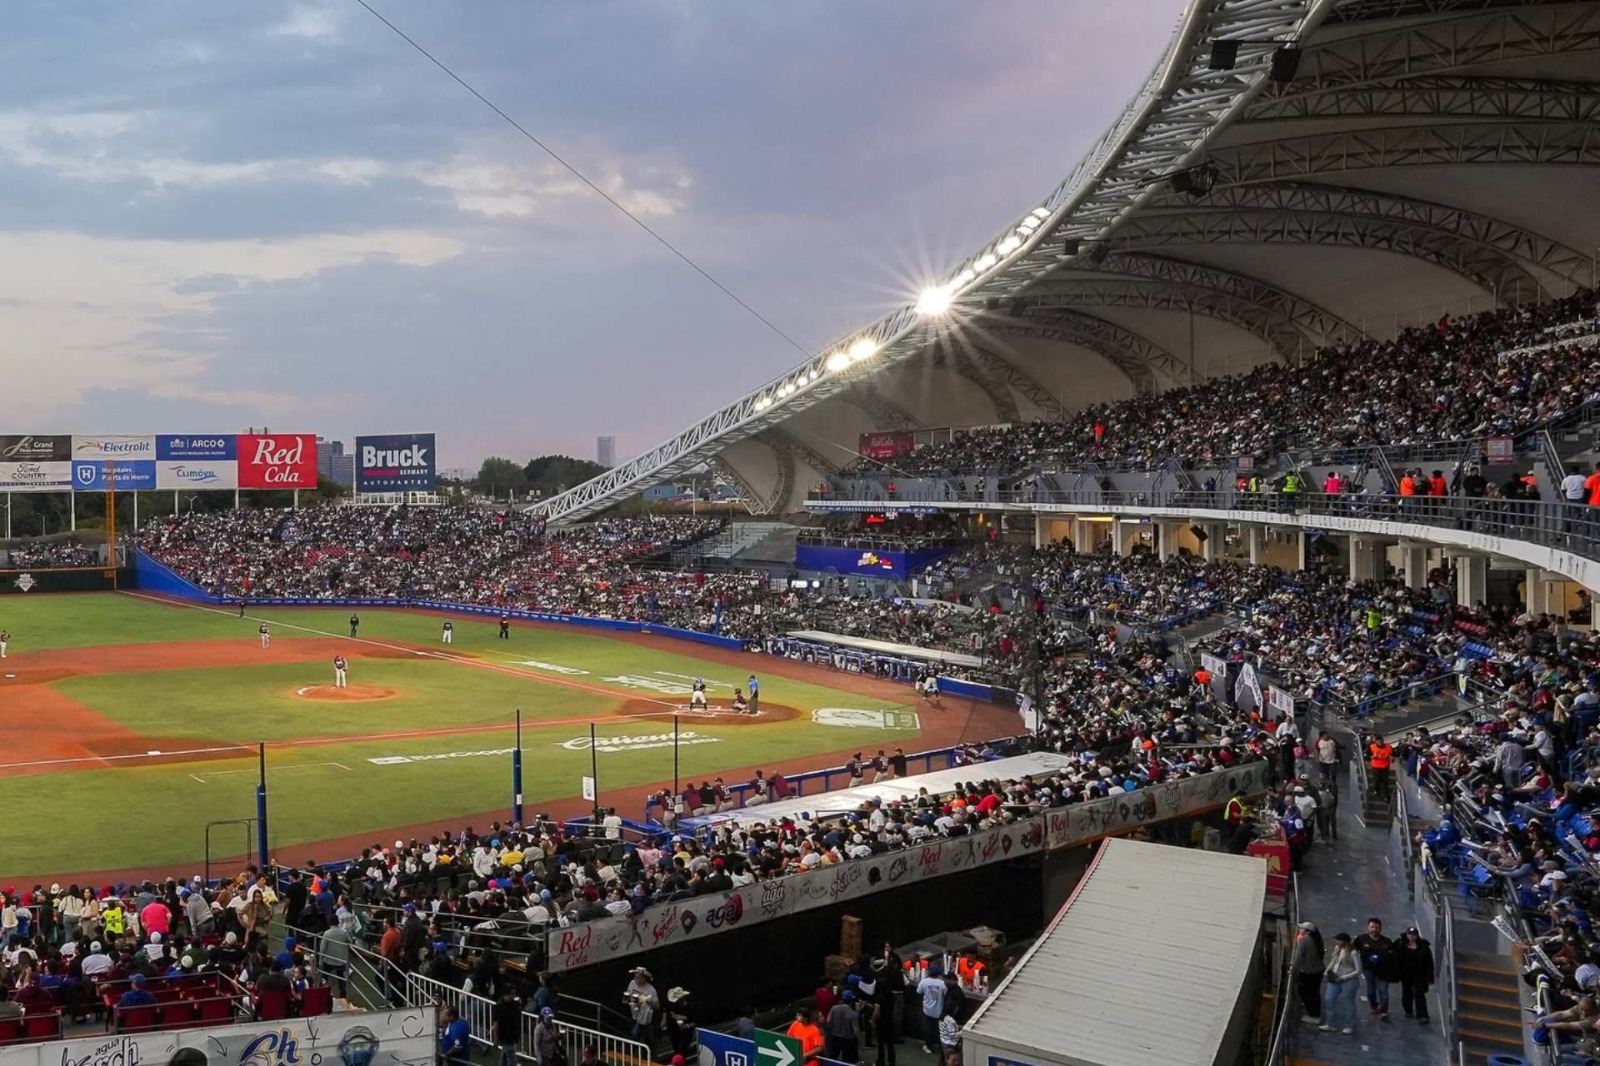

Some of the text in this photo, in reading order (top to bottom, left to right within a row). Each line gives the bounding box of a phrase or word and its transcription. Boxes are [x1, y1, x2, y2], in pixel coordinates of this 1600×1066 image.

[103, 441, 151, 452] Electrolit
[191, 439, 217, 448] ARCO
[250, 436, 304, 465] Red
[362, 444, 428, 468] Bruck
[264, 465, 300, 483] Cola
[1050, 810, 1070, 834] Red
[919, 844, 941, 866] Red
[706, 902, 736, 928] aga
[558, 925, 592, 956] Red
[565, 950, 588, 968] Cola
[95, 1038, 120, 1056] agua
